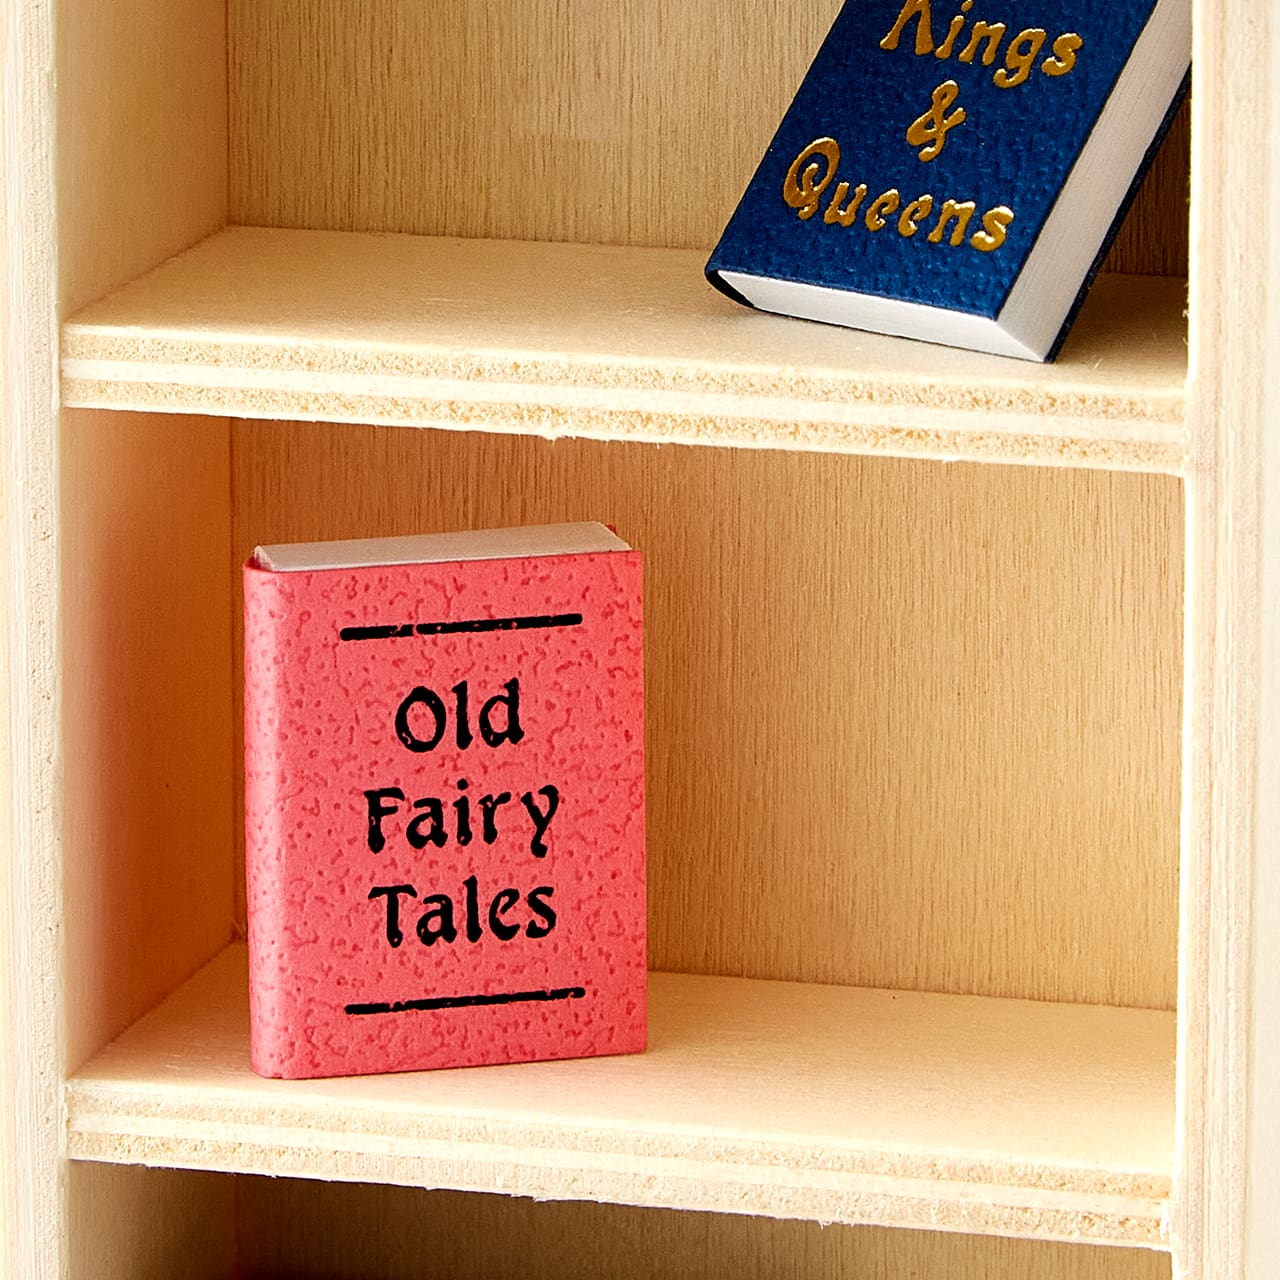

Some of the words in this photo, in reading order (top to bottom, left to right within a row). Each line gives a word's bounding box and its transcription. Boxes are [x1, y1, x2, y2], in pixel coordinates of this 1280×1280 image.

[906, 79, 967, 162] &
[783, 136, 1015, 252] Queens
[395, 677, 525, 753] Old
[364, 779, 559, 858] Fairy
[368, 875, 557, 948] Tales
